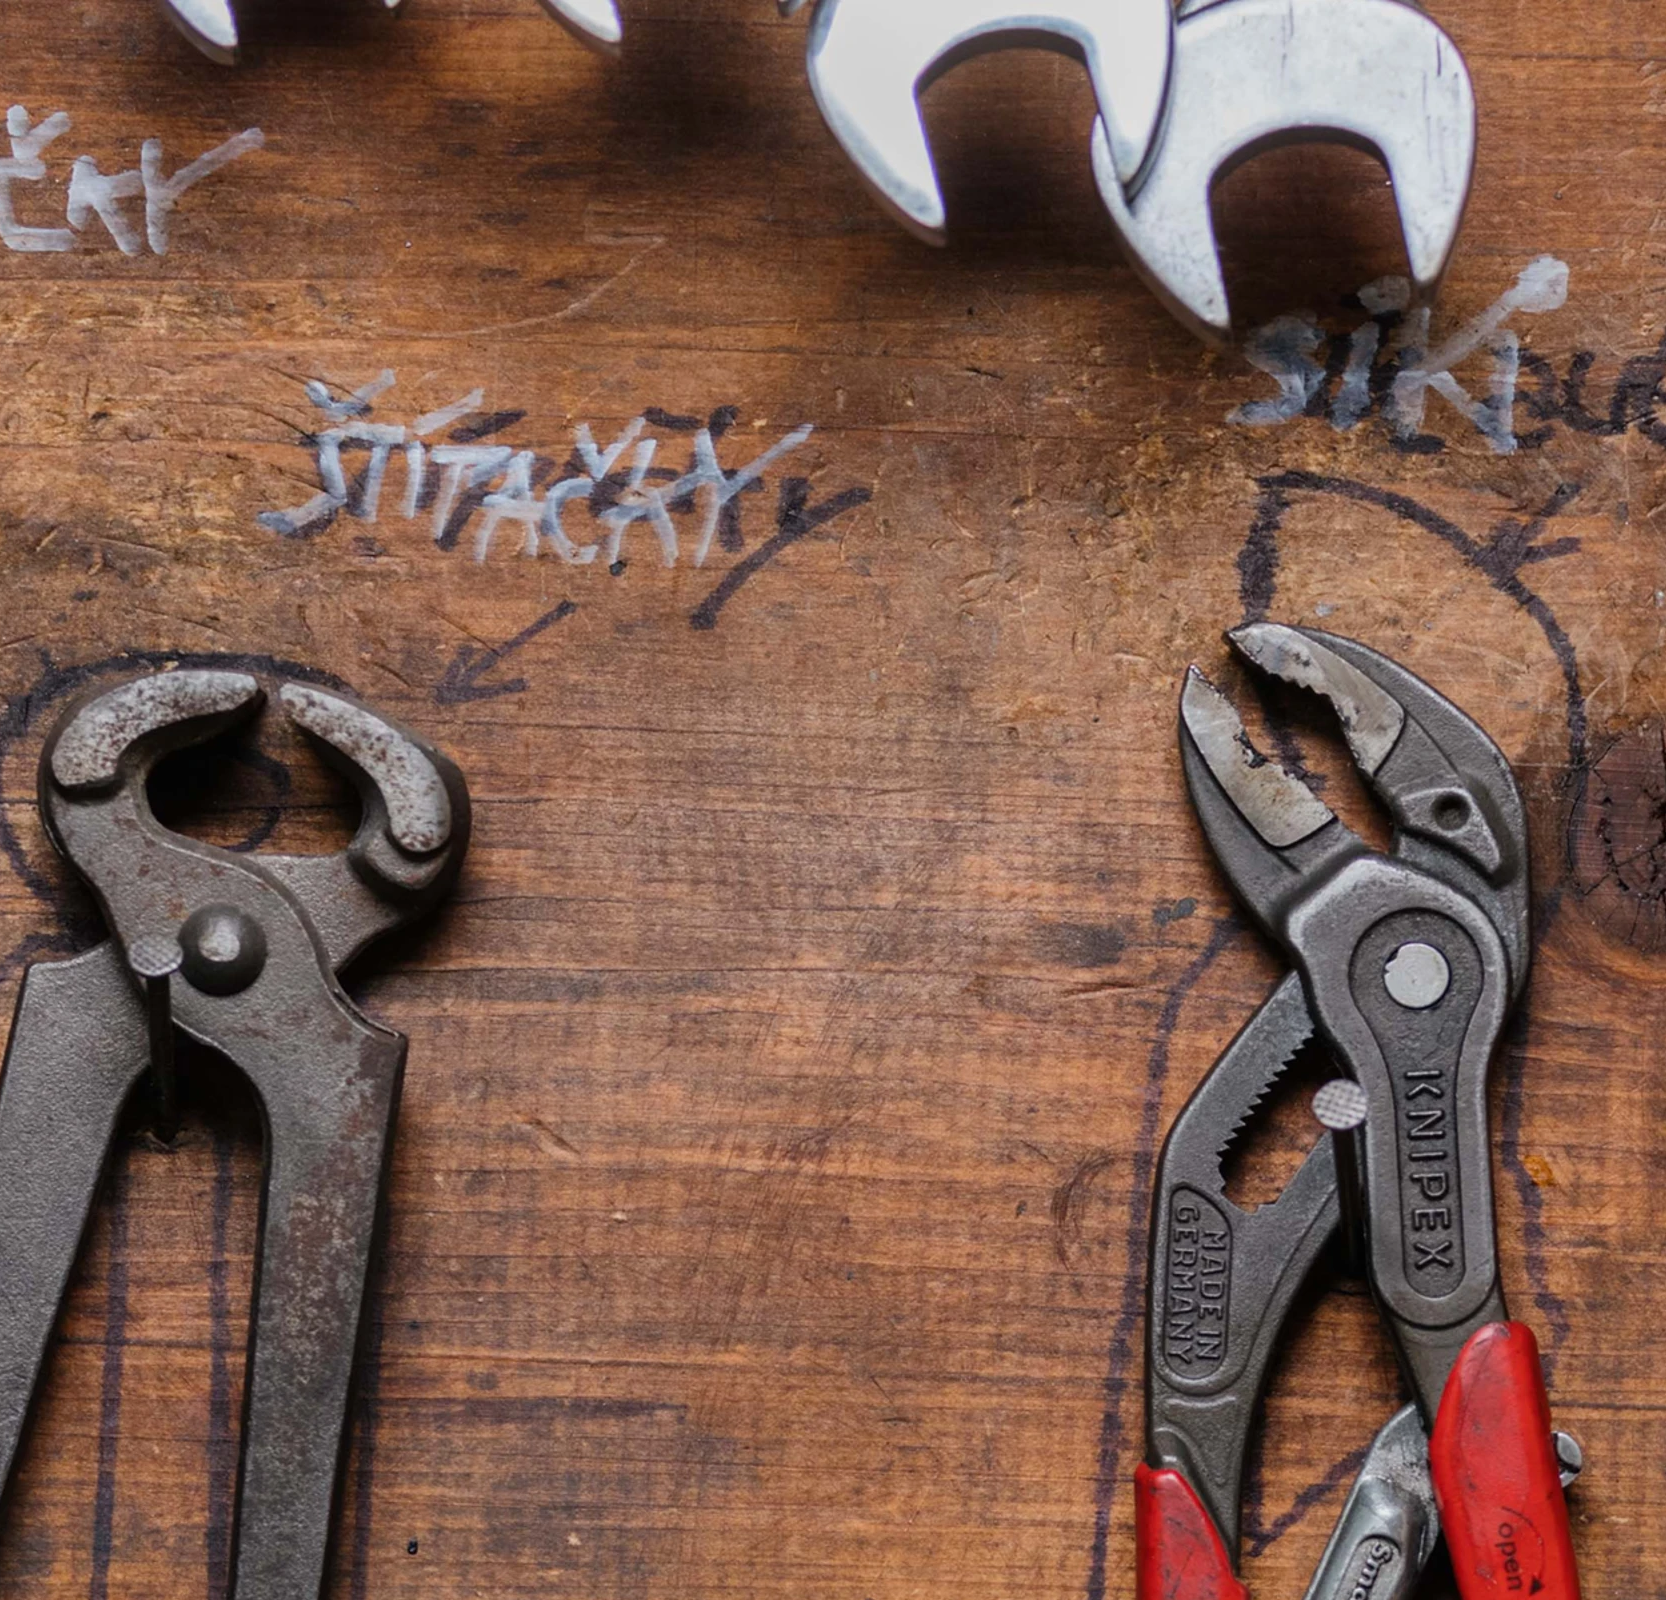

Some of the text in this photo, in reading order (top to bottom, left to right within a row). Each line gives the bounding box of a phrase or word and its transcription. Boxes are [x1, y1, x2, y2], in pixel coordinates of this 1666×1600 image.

[1404, 1068, 1456, 1272] KNIPEX
[1167, 1203, 1200, 1366] GERMANY
[1197, 1229, 1227, 1361] MADE IN
[1496, 1522, 1526, 1592] open
